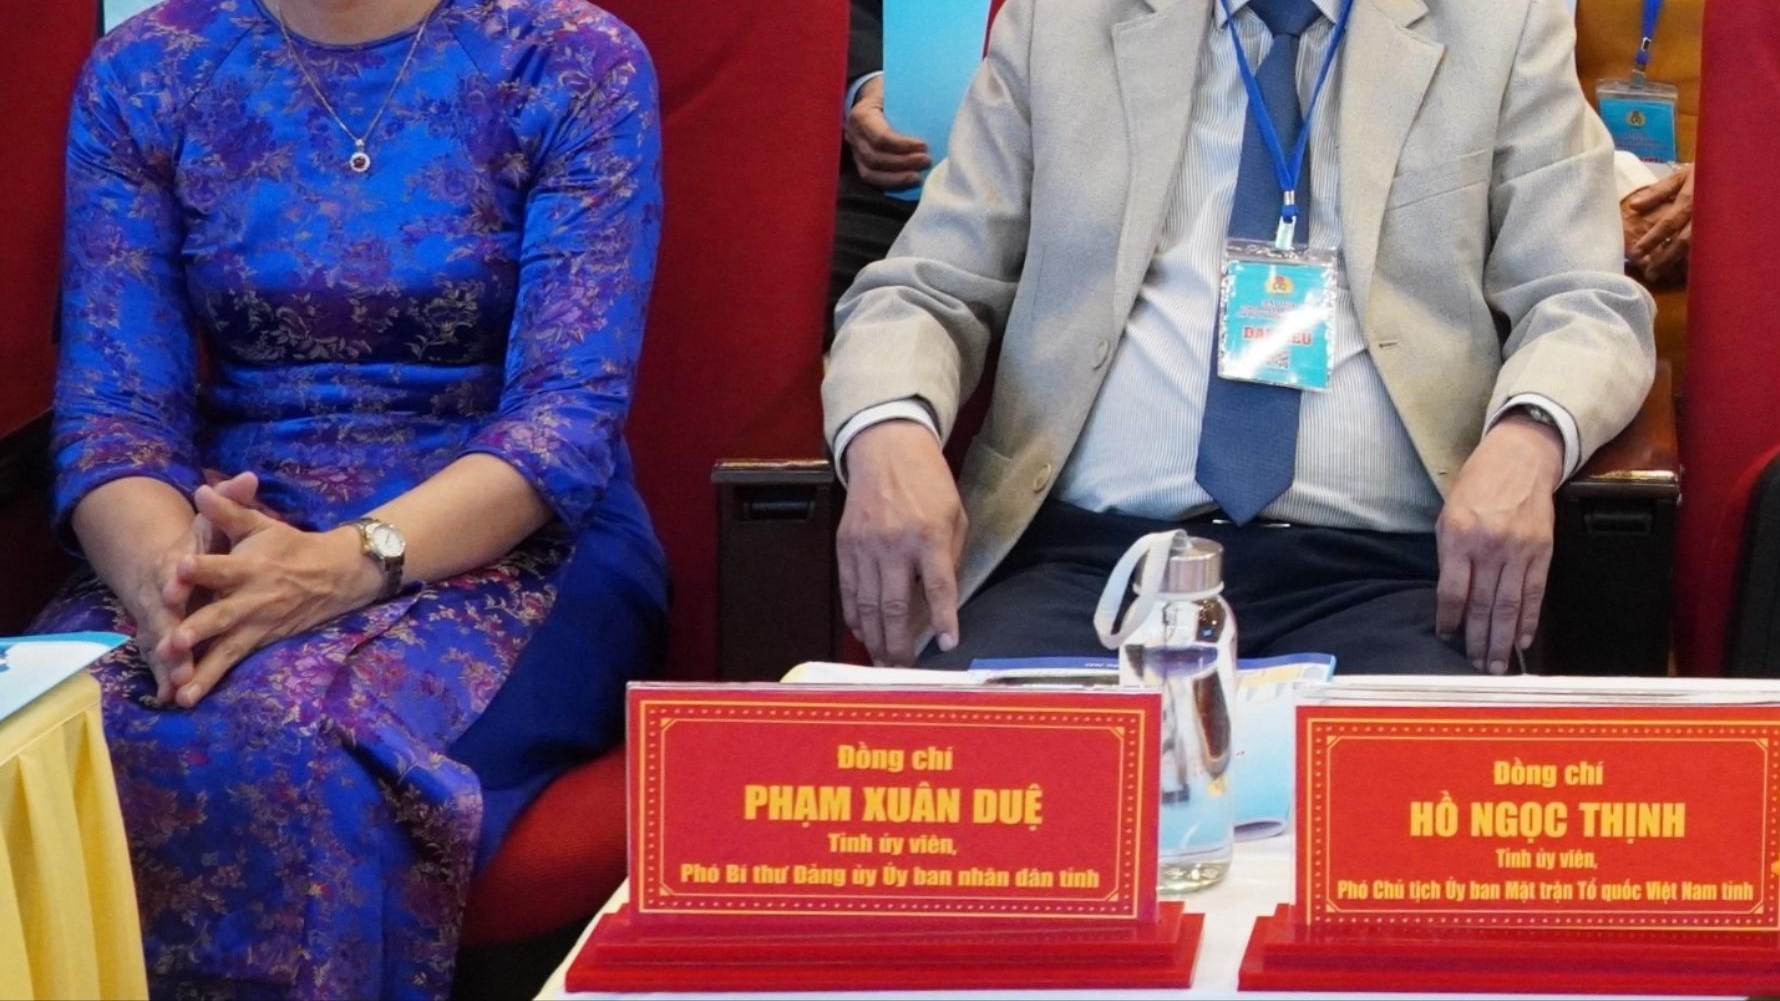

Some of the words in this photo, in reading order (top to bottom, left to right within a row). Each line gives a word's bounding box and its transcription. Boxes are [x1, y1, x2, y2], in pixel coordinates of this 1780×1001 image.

[837, 741, 904, 772] Đồng
[911, 745, 953, 771] chí
[1493, 757, 1557, 788] Đồng
[1564, 761, 1604, 786] chí
[744, 784, 851, 827] PHẠM
[862, 781, 960, 823] XUÂN
[972, 782, 1043, 831] DUỆ
[1410, 789, 1459, 837] HỒ
[1470, 801, 1568, 844] NGỌC
[1579, 802, 1686, 845] THỊNH
[909, 834, 957, 856] viên,
[1496, 848, 1532, 869] Tỉnh
[1559, 849, 1598, 870] viên,
[680, 863, 720, 884] Phó
[726, 864, 748, 884] Bí
[753, 864, 790, 884] thư
[792, 863, 846, 887] Đảng
[882, 861, 909, 887] Ủy
[913, 866, 953, 886] ban
[958, 867, 1010, 887] nhân
[1015, 867, 1054, 888] dân
[1059, 867, 1100, 889] tỉnh
[1337, 879, 1369, 900] Phó
[1372, 878, 1405, 900] Chủ
[1409, 880, 1441, 903] tịch
[1445, 876, 1466, 902] Ủy
[1470, 880, 1501, 900] ban
[1504, 880, 1536, 904] Mặt
[1540, 880, 1574, 904] trận
[1577, 877, 1598, 901] Tổ
[1601, 878, 1642, 902] quốc
[1645, 881, 1678, 905] Việt
[1681, 881, 1718, 901] Nam
[1721, 880, 1754, 901] tỉnh
